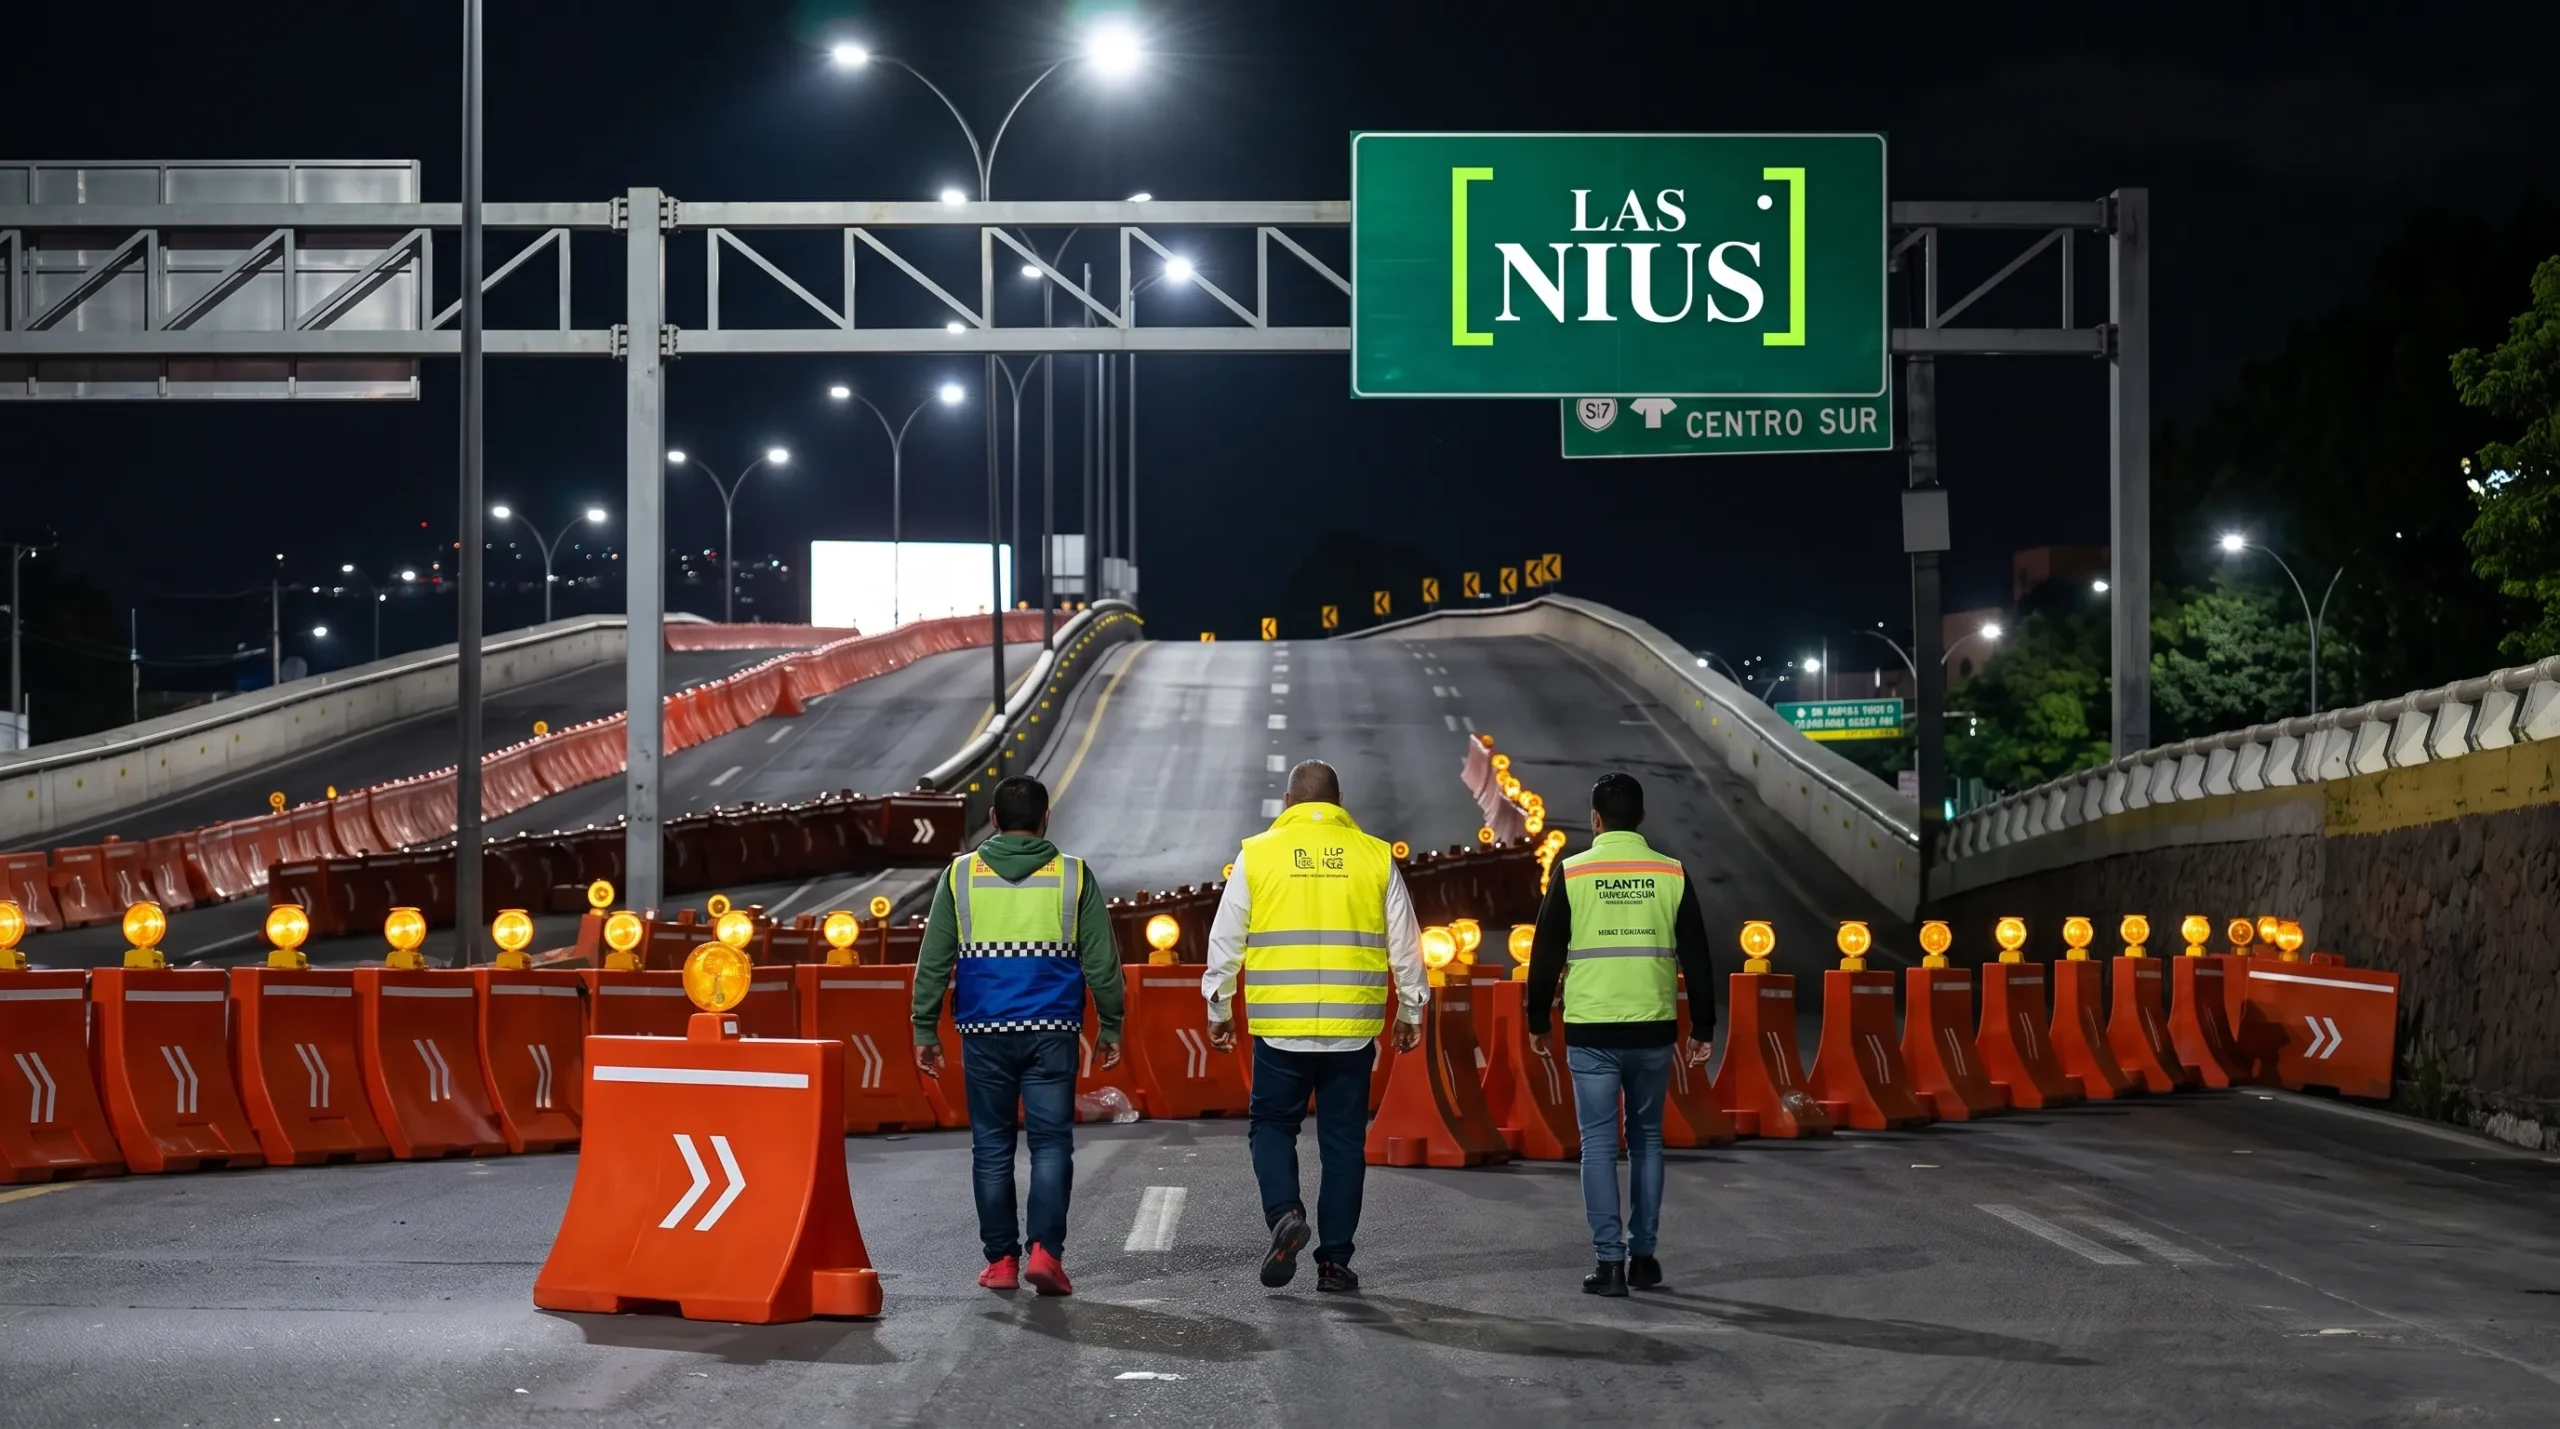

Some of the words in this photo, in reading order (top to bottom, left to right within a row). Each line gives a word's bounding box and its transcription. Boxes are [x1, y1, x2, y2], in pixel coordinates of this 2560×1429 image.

[1570, 188, 1687, 232] LAS
[1495, 241, 1765, 323] NIUS
[1686, 408, 1803, 438] CENTRO
[1819, 407, 1878, 434] SUR
